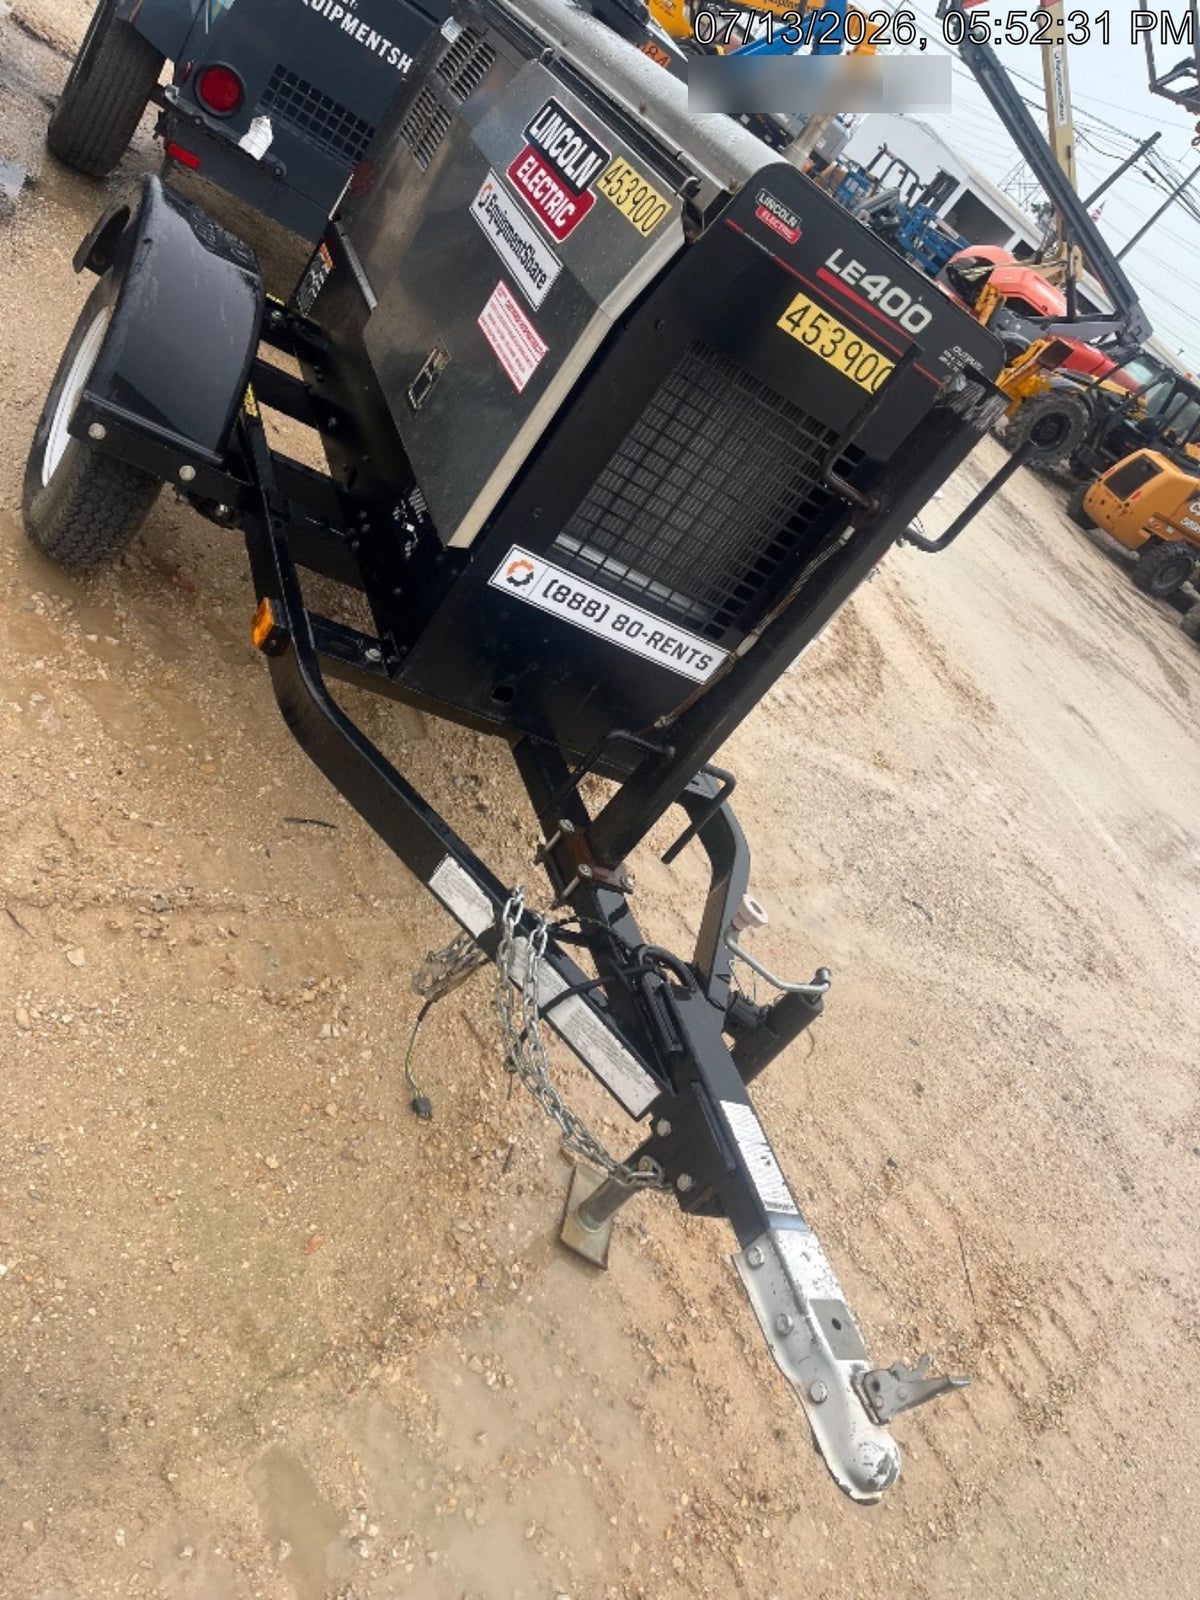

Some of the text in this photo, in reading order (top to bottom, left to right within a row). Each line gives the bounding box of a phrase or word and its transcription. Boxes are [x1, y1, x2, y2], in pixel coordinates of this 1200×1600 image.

[529, 105, 603, 191] LINCOLN
[516, 155, 578, 228] ELECTRIC
[602, 162, 666, 234] 453900
[758, 191, 799, 229] LINCOLN
[485, 193, 547, 290] EquipmentShare
[824, 248, 933, 334] LE400
[542, 578, 713, 671] (888) 80-RENTS
